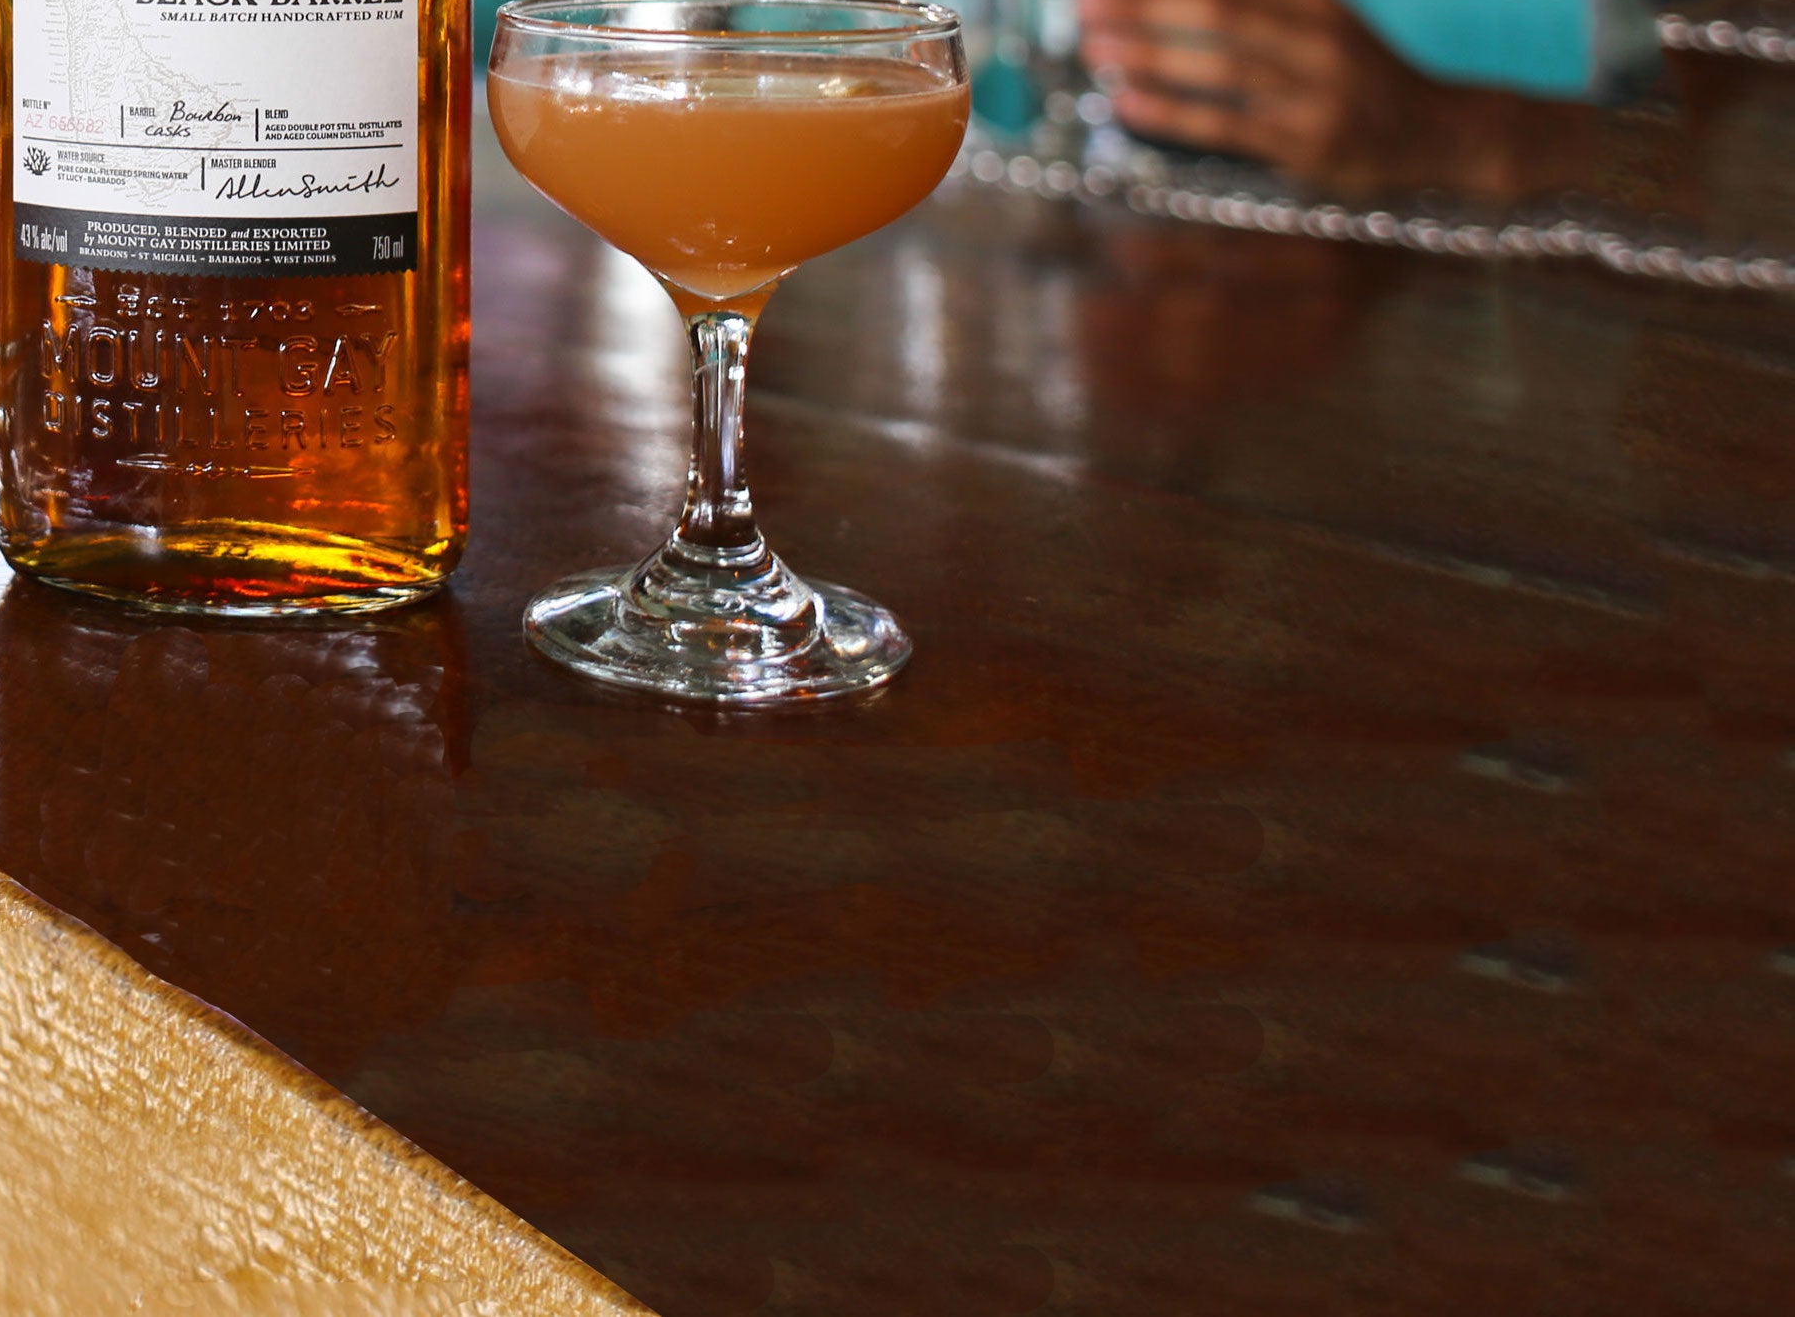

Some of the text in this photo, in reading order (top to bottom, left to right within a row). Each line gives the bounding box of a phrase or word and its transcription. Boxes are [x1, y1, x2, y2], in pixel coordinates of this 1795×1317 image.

[160, 10, 404, 22] SMALL BATCH HANDCRAFTED RUM
[22, 98, 43, 110] BOTTLE
[129, 106, 156, 117] BARREL
[265, 109, 289, 119] BLEND
[265, 124, 286, 132] AGED
[287, 123, 319, 131] DOUBLE
[337, 122, 356, 130] STILL
[359, 120, 403, 129] DISTILLATES
[284, 132, 305, 140] AGED
[306, 131, 339, 140] COLUMN
[340, 130, 385, 139] DISTILLATES
[57, 150, 105, 163] WATER SOURCE
[211, 158, 277, 169] MASTER BLENDER
[57, 165, 74, 173] PURE
[75, 166, 132, 178] CORAL-FILTERED
[133, 170, 160, 179] SPRING
[162, 171, 188, 180] WATER
[66, 174, 83, 183] LUCY
[87, 176, 126, 185] BARBADOS
[87, 221, 327, 239] PRODUCED, BLENDED and EXPORTED
[84, 233, 331, 251] by MOUNT GAY DISTILLERIES LIMITED
[79, 246, 336, 264] BRANDONS ST MICHAEL BARBADOS WEST INDIES
[41, 319, 399, 397] MOUNT GAY
[42, 390, 398, 450] DISTILLERIES
